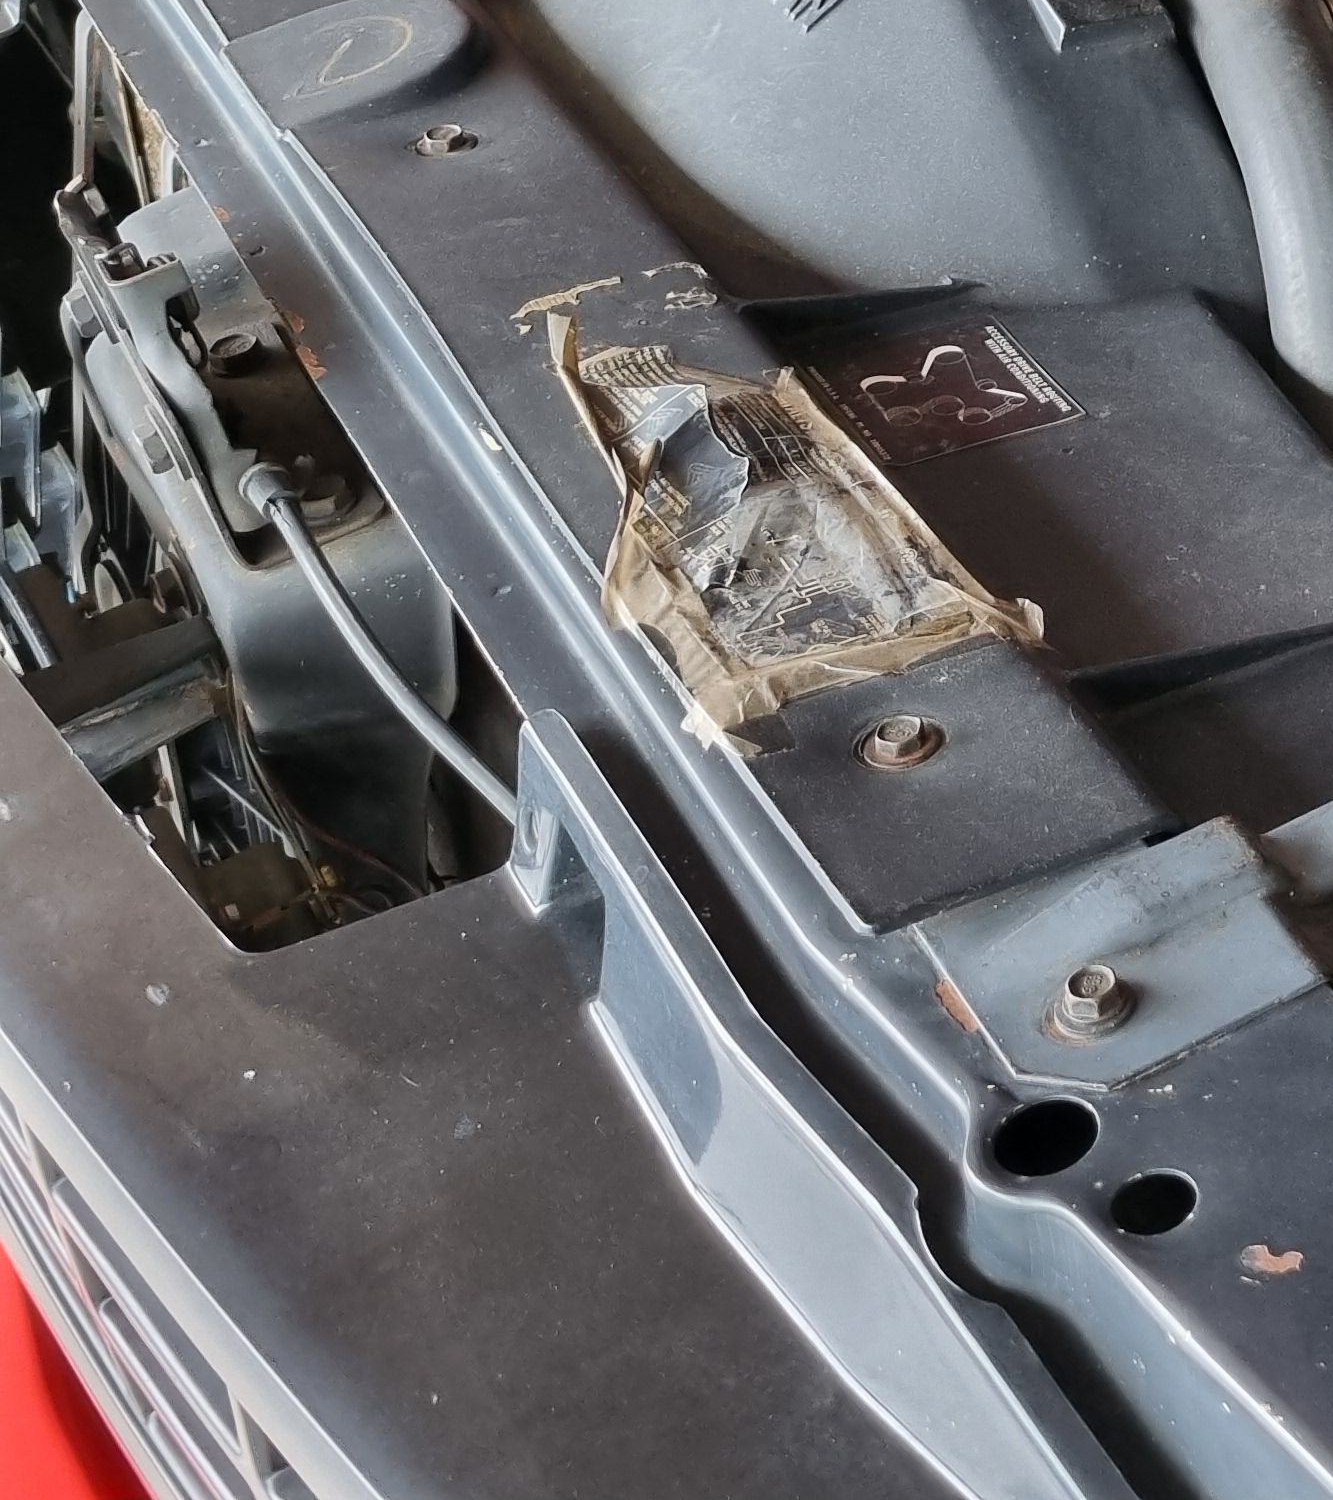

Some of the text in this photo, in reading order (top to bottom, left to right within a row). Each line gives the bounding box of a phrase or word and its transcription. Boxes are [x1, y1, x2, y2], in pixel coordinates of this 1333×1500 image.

[984, 325, 1072, 412] ACCESSORY DRIVE BELT ROUTING
[984, 338, 1049, 404] WITH AIR CONDITIONING
